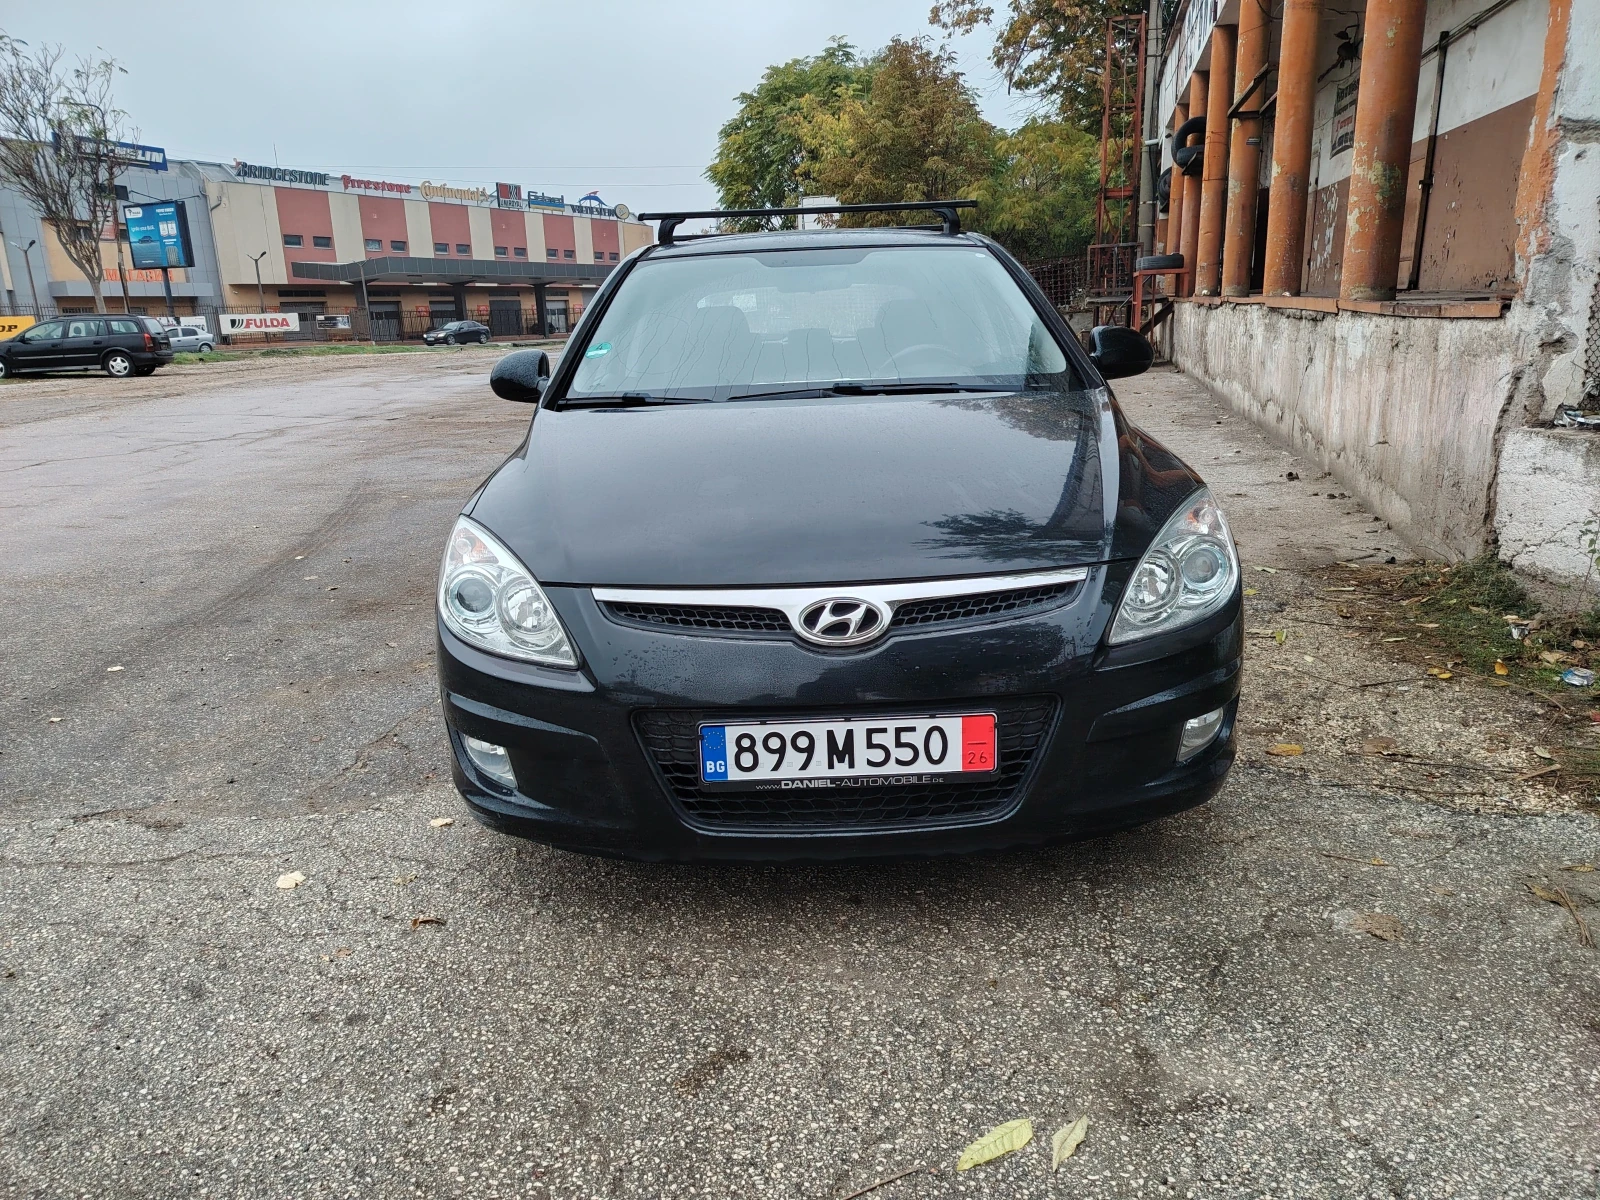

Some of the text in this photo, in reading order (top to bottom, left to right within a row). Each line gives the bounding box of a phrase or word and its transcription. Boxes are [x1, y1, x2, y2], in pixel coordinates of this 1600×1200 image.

[236, 161, 330, 186] BRIDGESTONE
[341, 175, 411, 193] Firestone
[105, 268, 175, 282] МГАЗИН
[243, 317, 291, 329] FULDA
[967, 751, 988, 765] 26
[706, 760, 726, 773] BG
